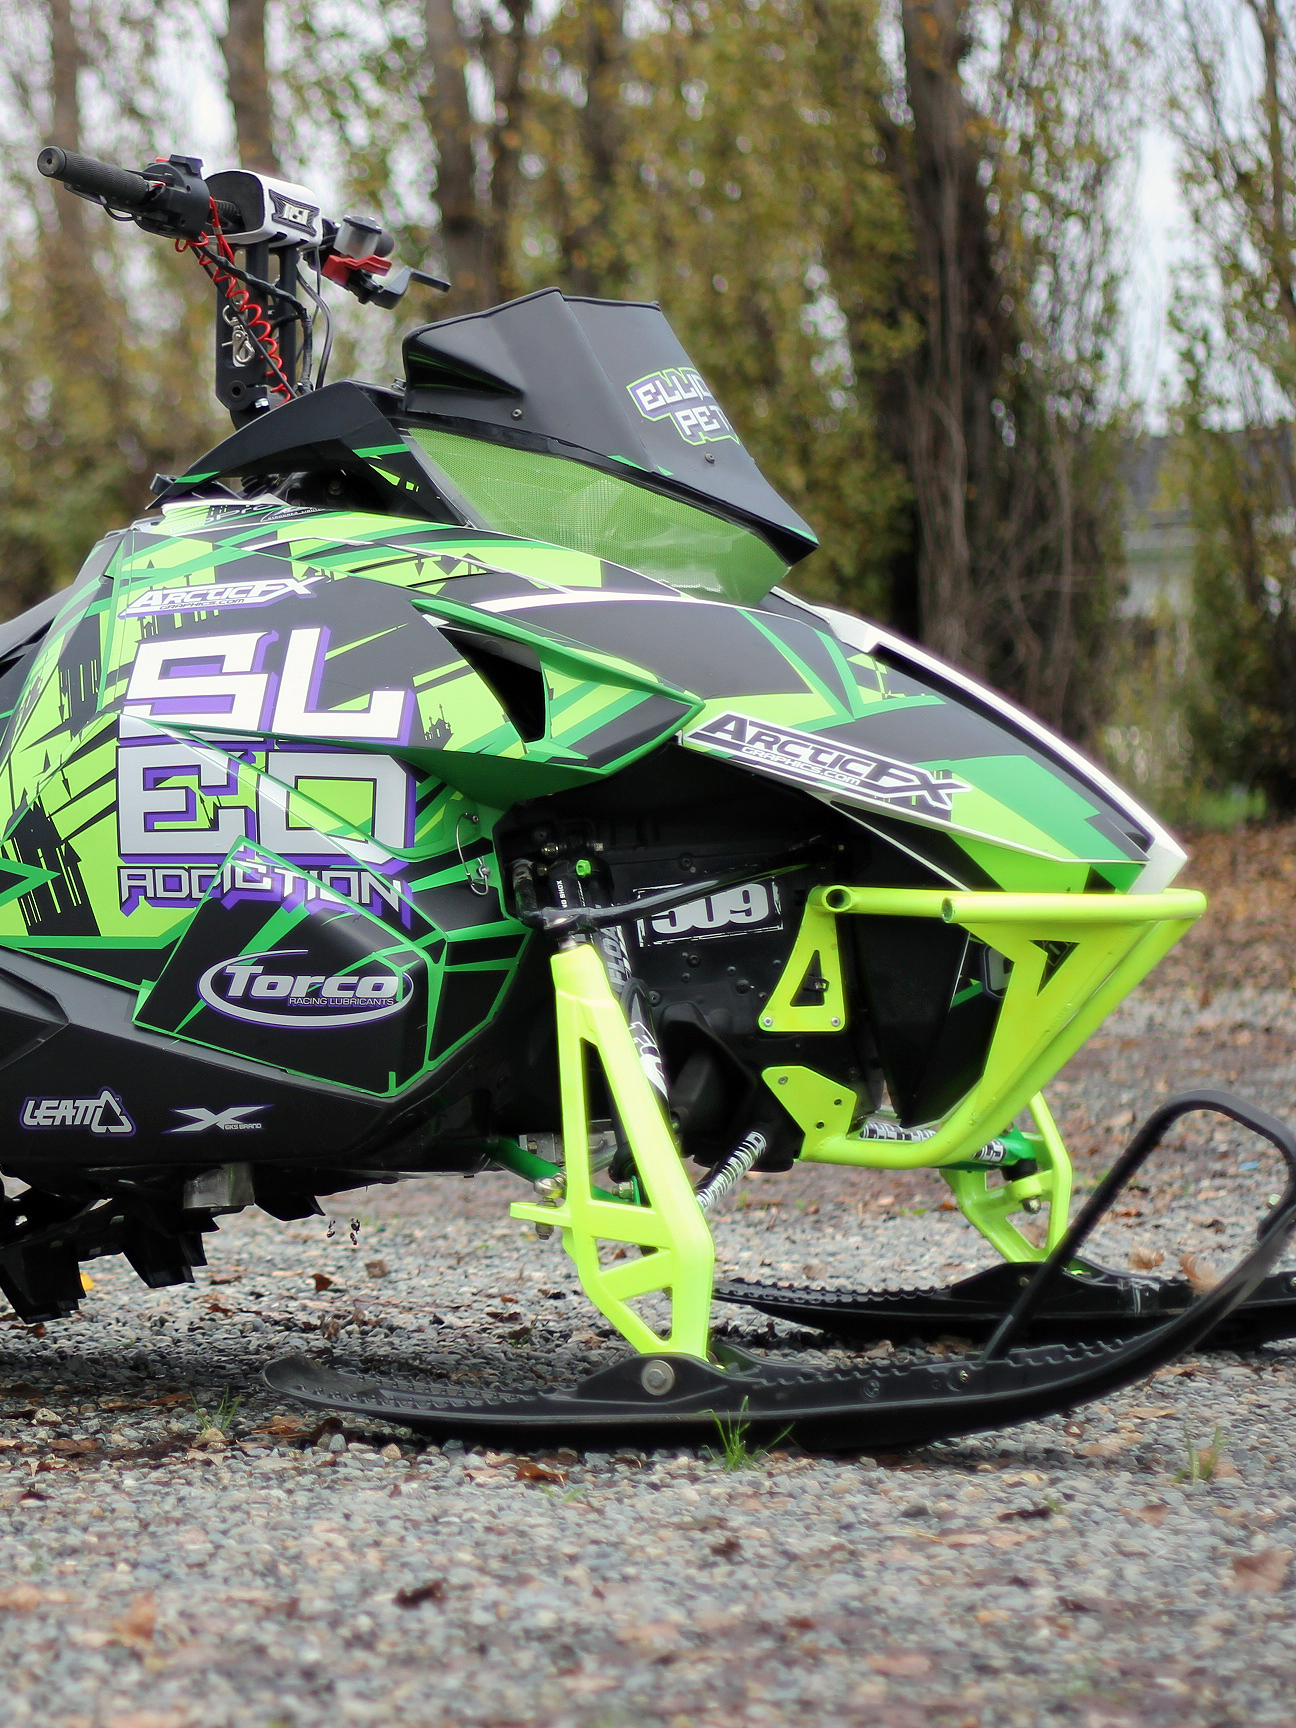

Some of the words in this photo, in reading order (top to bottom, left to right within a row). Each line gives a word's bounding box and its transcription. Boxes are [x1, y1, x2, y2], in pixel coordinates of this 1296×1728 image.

[119, 627, 405, 742] SL
[119, 859, 402, 913] ADDICTION
[224, 965, 399, 997] Torco
[289, 997, 327, 1006] RACING
[329, 997, 395, 1007] LUBRICANTS
